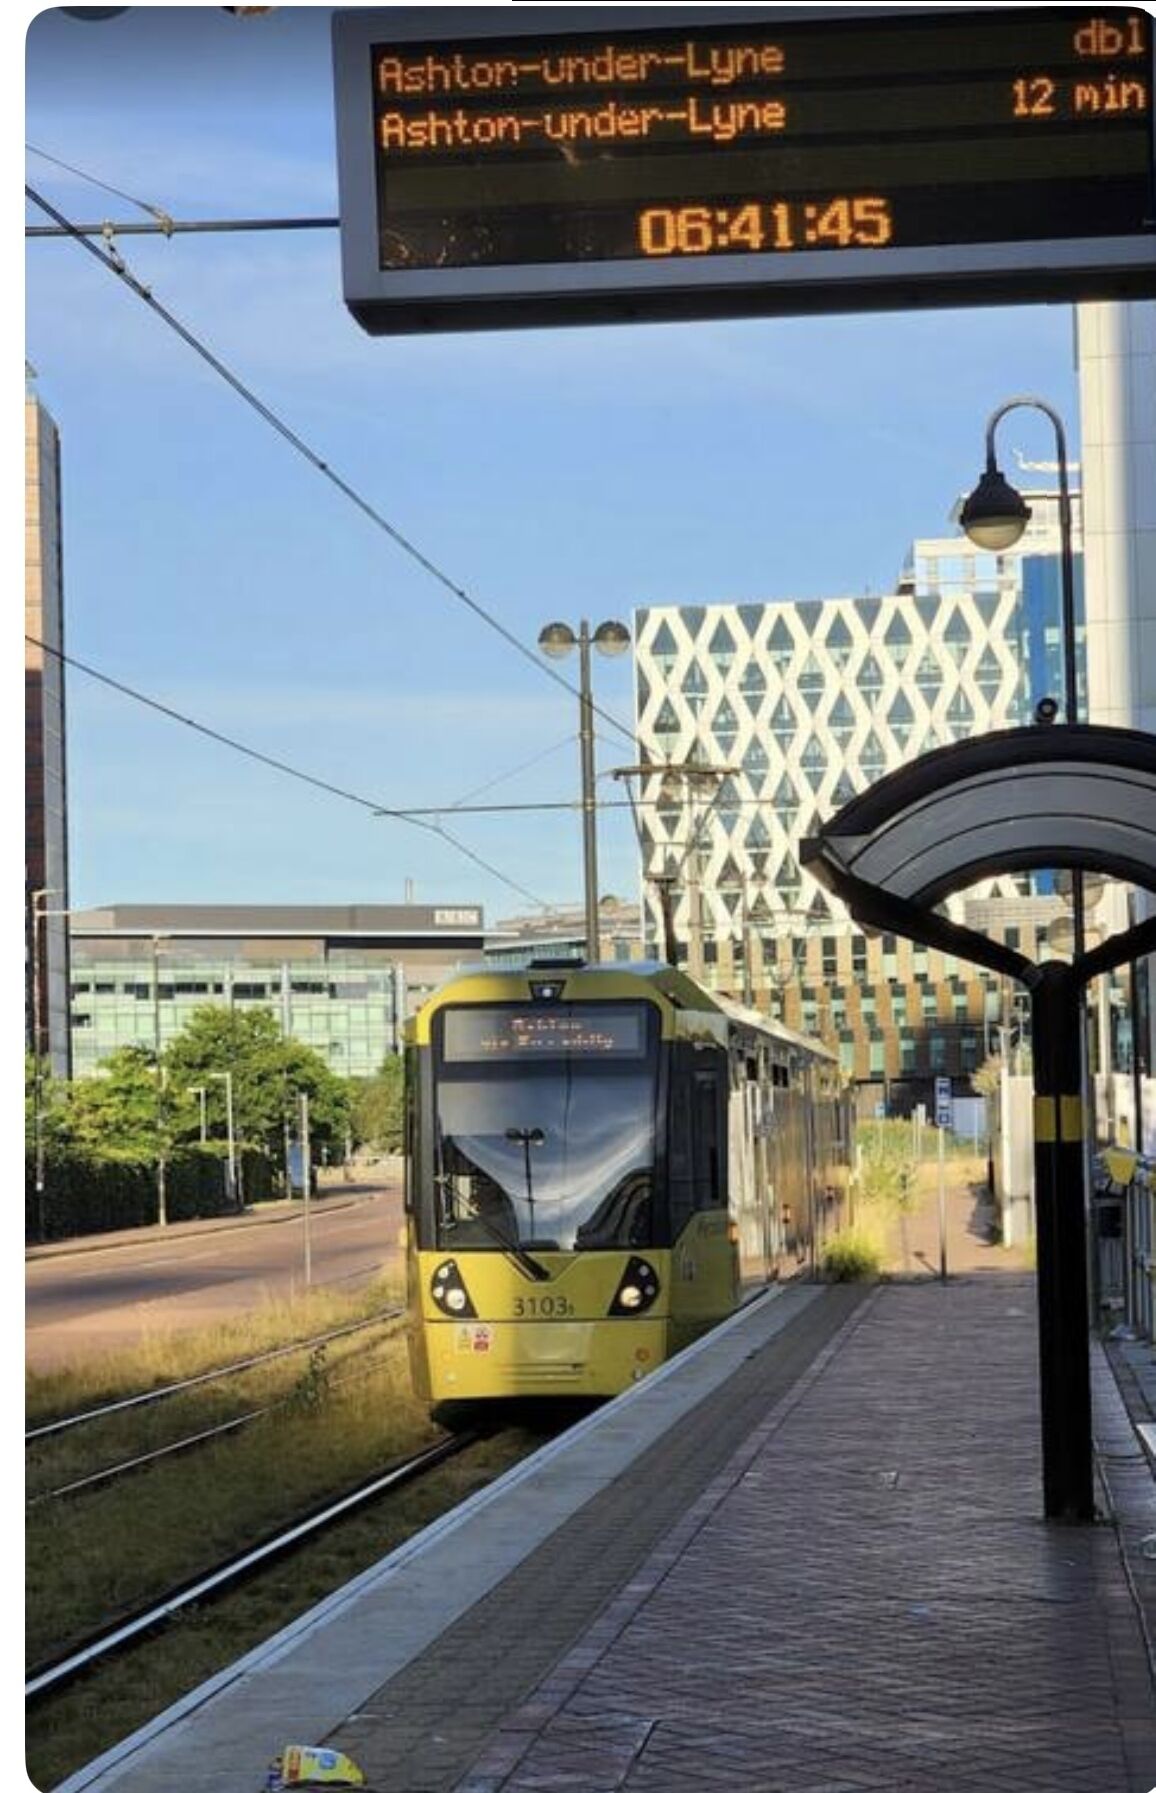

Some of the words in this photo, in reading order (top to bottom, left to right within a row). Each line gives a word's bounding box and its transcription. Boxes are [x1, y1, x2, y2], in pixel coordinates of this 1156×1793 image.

[379, 42, 785, 93] Ashton-under-Lyne
[380, 98, 787, 148] Ashton-under-Lyne
[1012, 79, 1055, 116] 12
[1074, 75, 1145, 111] min
[638, 197, 892, 255] 06:41:45
